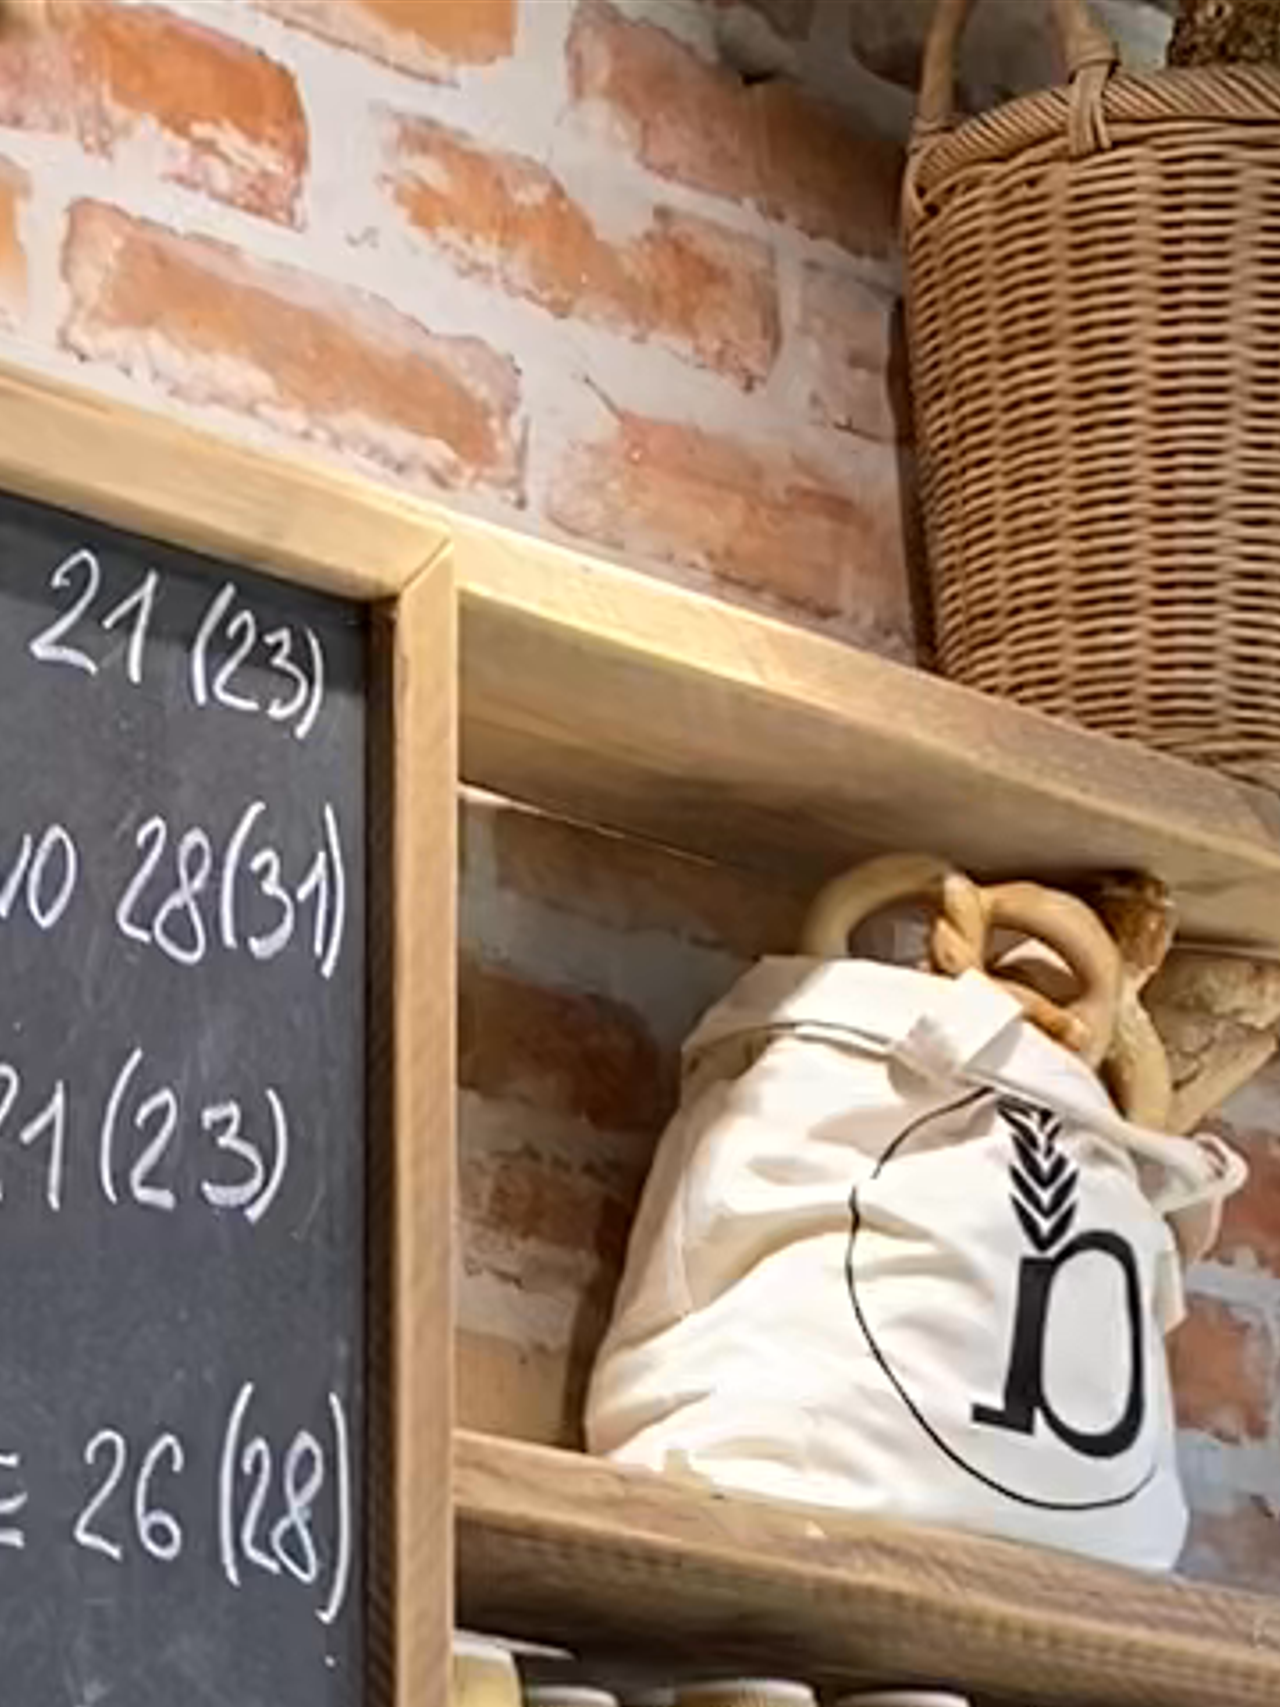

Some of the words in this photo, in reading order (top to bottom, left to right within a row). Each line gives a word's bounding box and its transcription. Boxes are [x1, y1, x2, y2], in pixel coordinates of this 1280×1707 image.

[28, 549, 157, 685] 21
[191, 583, 326, 738] (23)
[72, 1428, 184, 1562] 26
